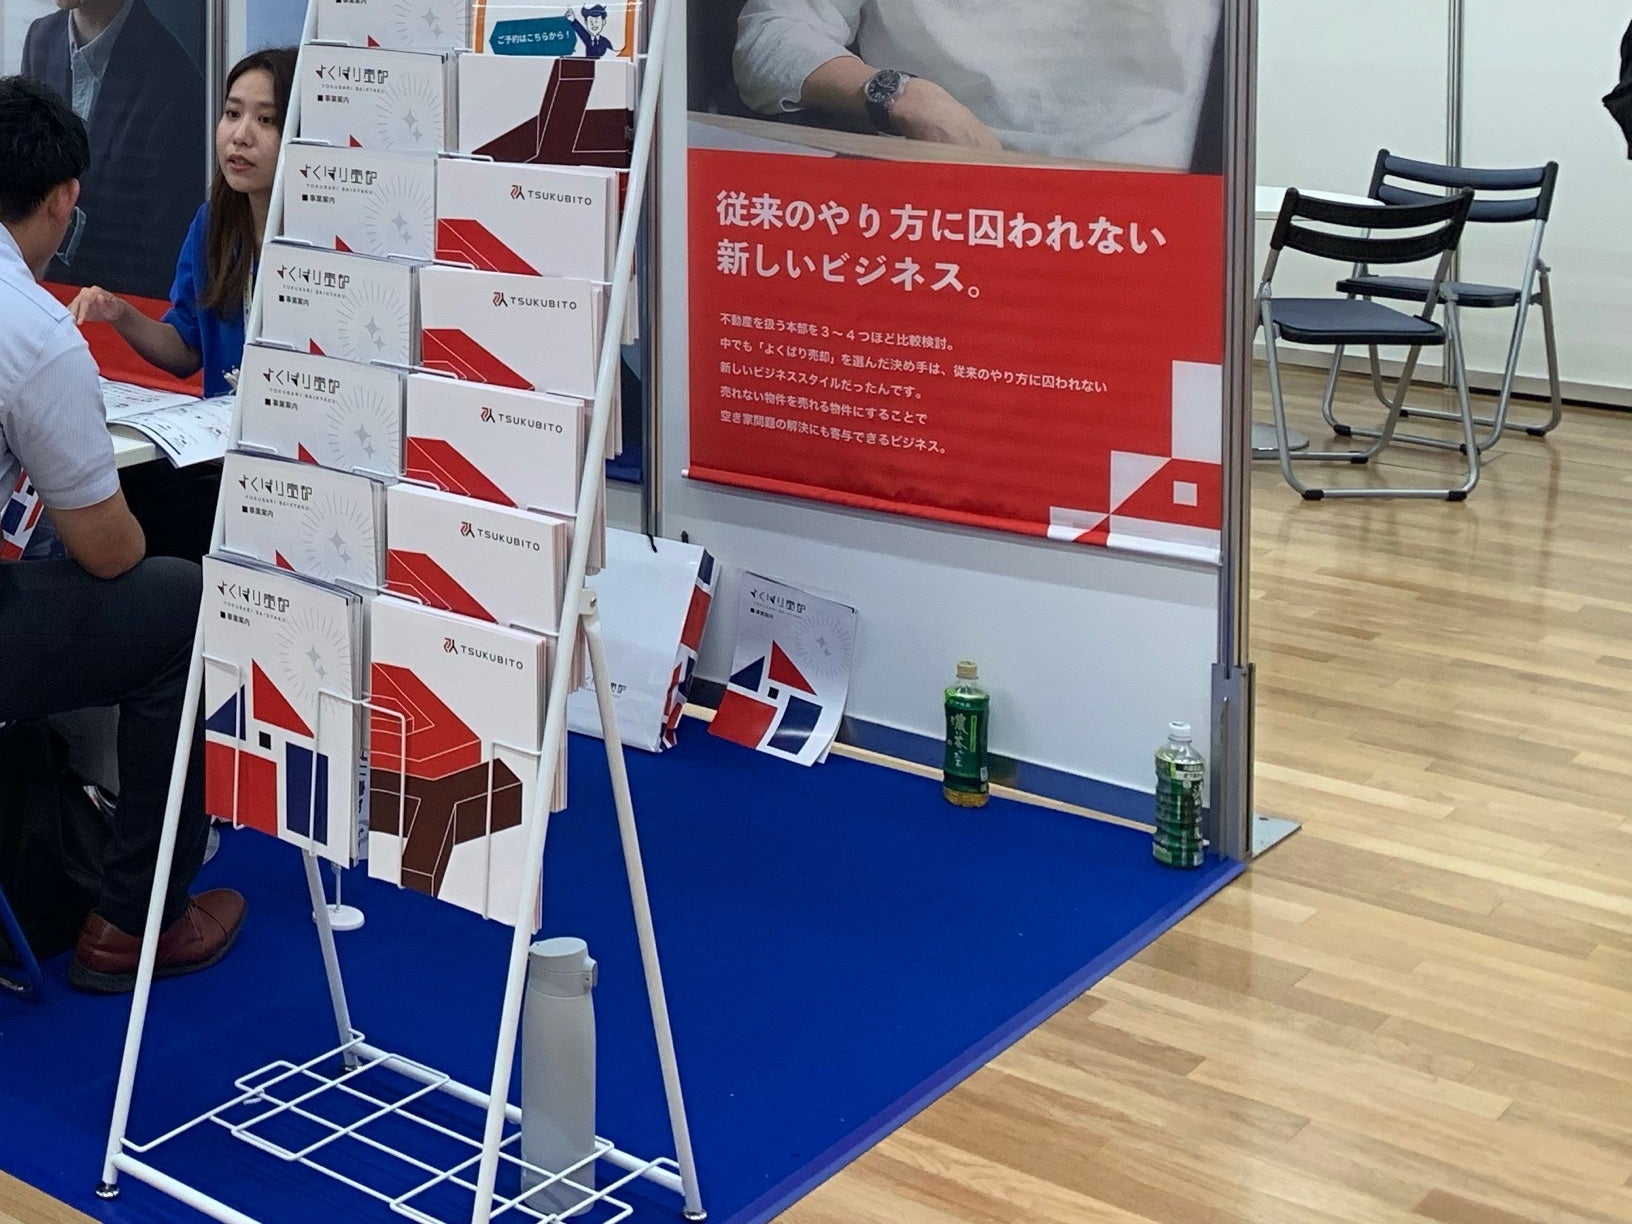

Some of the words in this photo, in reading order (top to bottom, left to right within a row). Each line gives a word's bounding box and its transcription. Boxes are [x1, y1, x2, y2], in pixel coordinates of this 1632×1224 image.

[497, 30, 570, 45] ご予約はこちらから！
[528, 190, 592, 206] TSUKUBITO
[716, 189, 1167, 254] 従来のやり方に囚われない
[716, 239, 981, 299] 新しいビジネス。
[510, 297, 577, 310] TSUKUBITO
[720, 337, 1109, 393] 中でも「よくばり売却」を選んだ決め手は、従来のやり方に囚われない
[720, 361, 922, 400] 新しいビジネススタイルだったんです。
[720, 385, 928, 426] 売れない物件を売れる物件にすることで
[498, 413, 563, 434] TSUKUBITO
[720, 409, 947, 455] 空き家問題の解決にも寄与できるビジネス。
[477, 528, 540, 551] TSUKUBITO
[460, 644, 524, 670] TSUKUBITO
